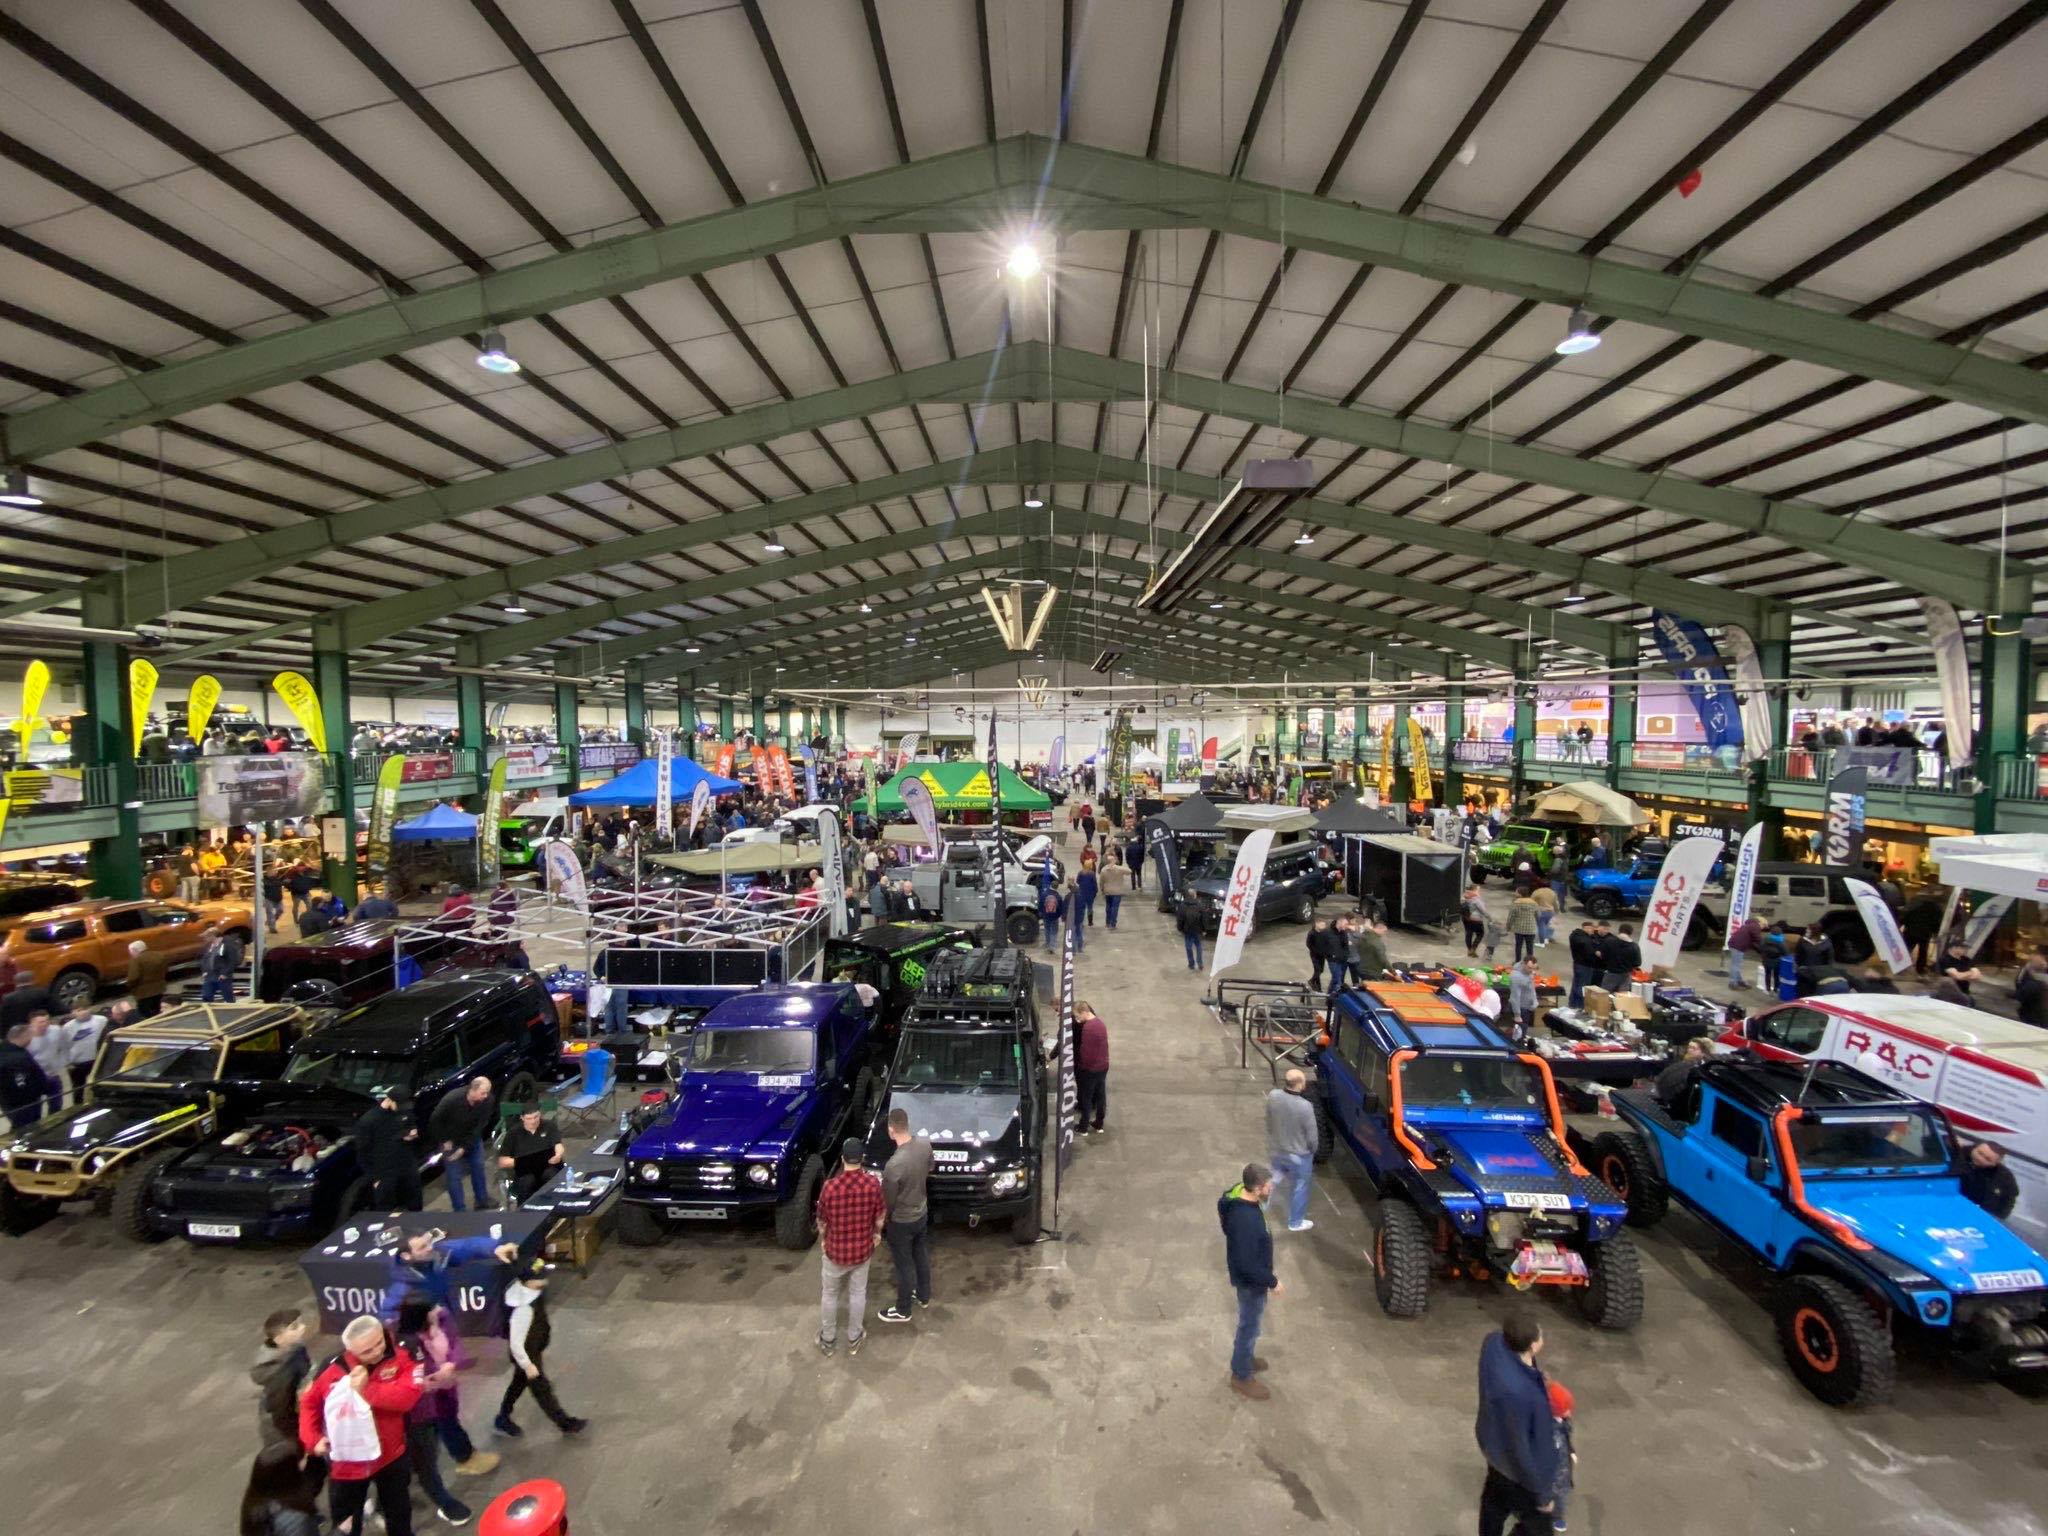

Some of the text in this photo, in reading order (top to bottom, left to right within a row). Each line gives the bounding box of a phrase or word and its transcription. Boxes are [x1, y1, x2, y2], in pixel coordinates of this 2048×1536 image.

[1675, 825, 1723, 838] STORM
[1826, 792, 1852, 866] TORM
[1845, 1031, 1934, 1079] RA.C
[1543, 1195, 1565, 1207] SUY
